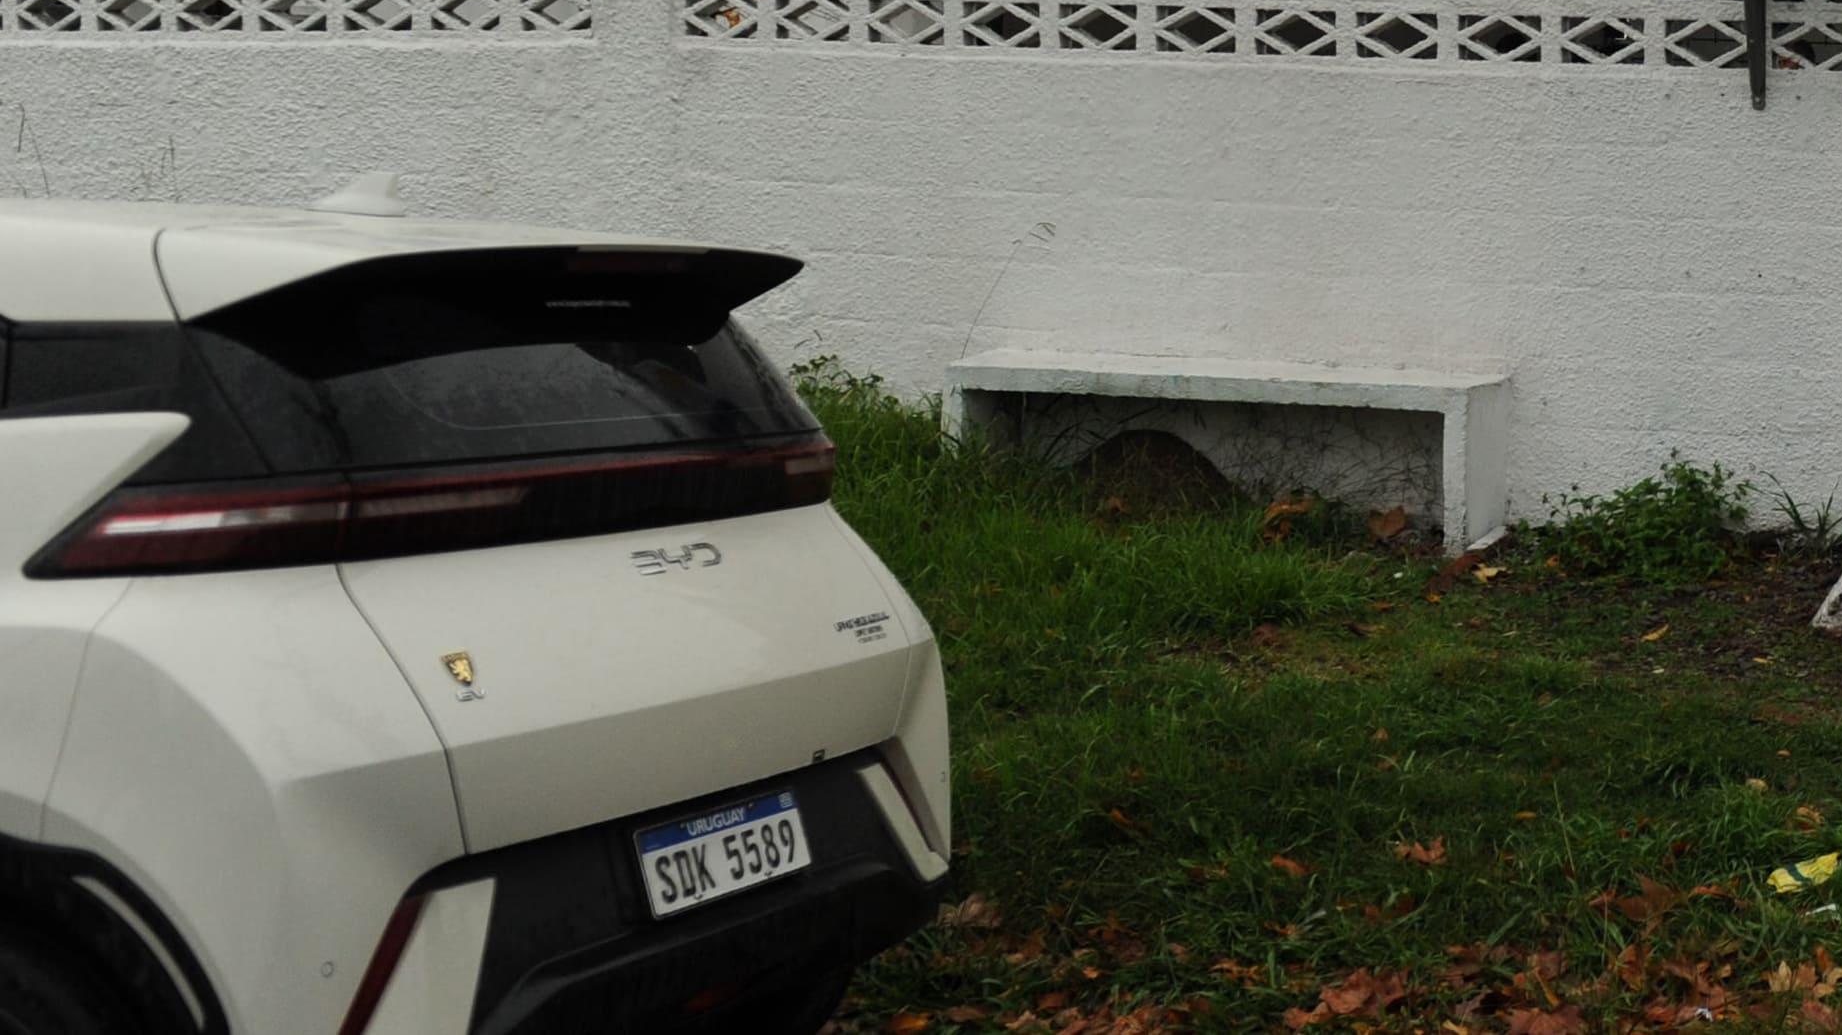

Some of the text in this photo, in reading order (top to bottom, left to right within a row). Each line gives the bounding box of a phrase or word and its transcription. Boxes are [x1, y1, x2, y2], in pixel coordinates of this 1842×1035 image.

[628, 542, 722, 576] BYD
[686, 807, 746, 836] URUGUAY
[655, 819, 795, 904] SDK 5589
